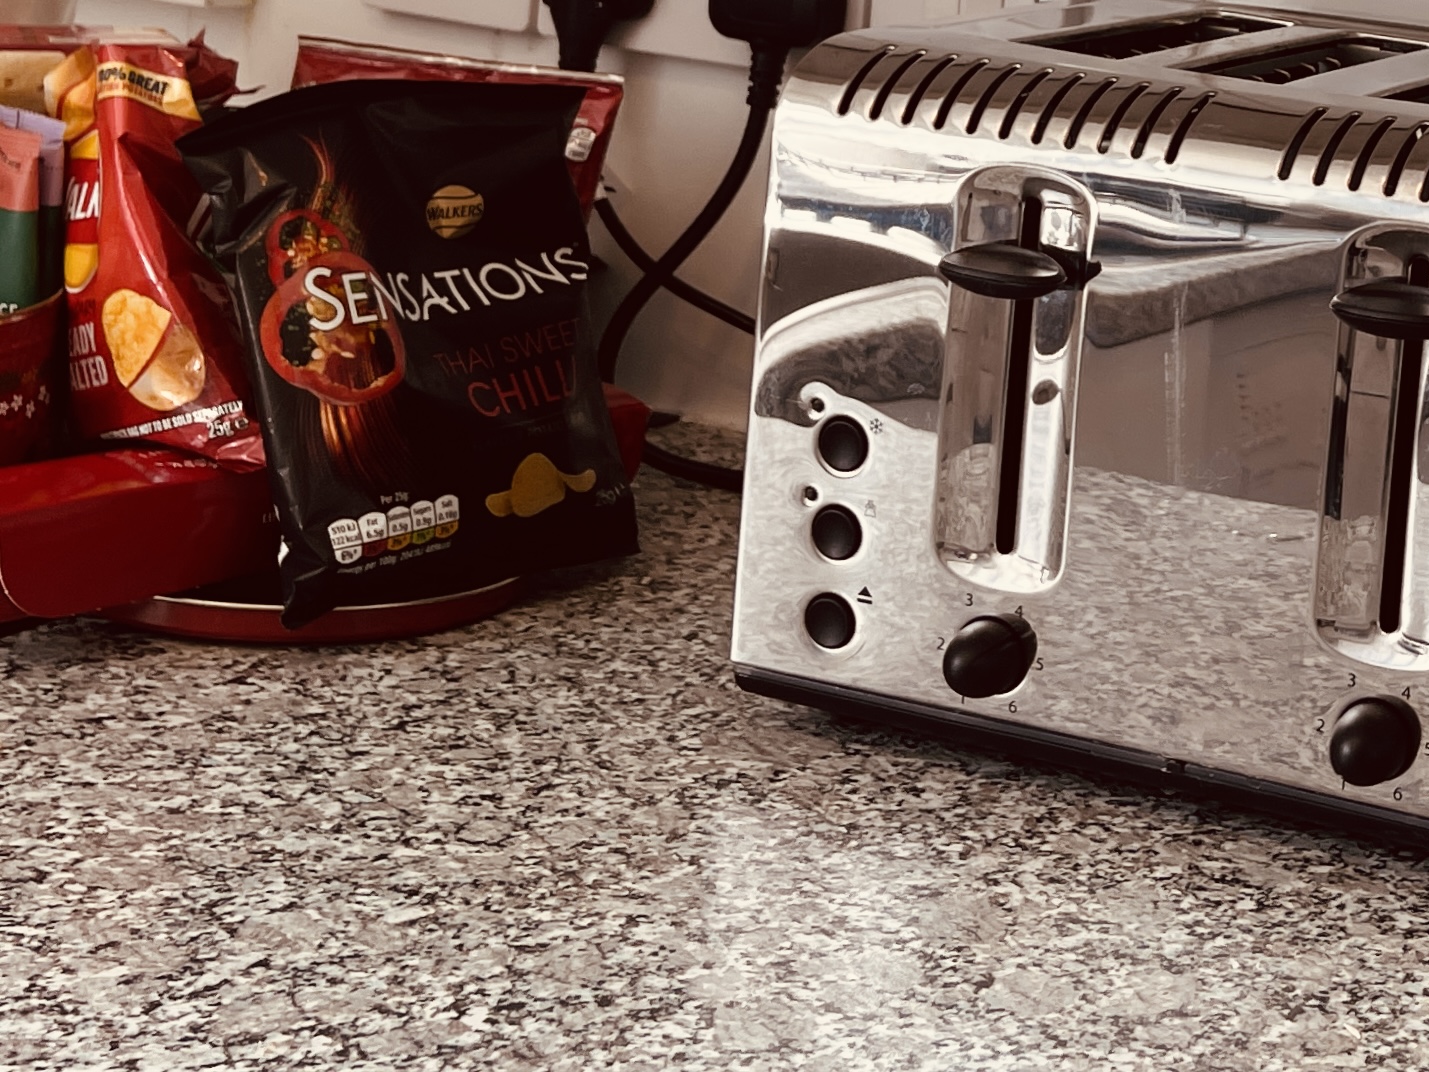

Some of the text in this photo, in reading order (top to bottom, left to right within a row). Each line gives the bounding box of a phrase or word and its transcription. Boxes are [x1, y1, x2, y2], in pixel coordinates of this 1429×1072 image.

[127, 70, 169, 96] GREAT
[427, 203, 483, 221] WALKERS
[303, 247, 589, 331] SENSATIONS
[432, 318, 581, 377] THAI SWEET
[153, 420, 163, 432] TO
[162, 418, 173, 431] BE
[172, 414, 193, 429] SOLD
[206, 419, 235, 439] 25g
[964, 593, 974, 607] 3
[1014, 605, 1024, 618] 4
[936, 636, 945, 650] 2
[1035, 657, 1045, 671] 5
[1347, 673, 1356, 687] 3
[1401, 686, 1411, 700] 4
[1008, 700, 1018, 713] 6
[1316, 718, 1325, 733] 2
[1393, 787, 1403, 801] 6
